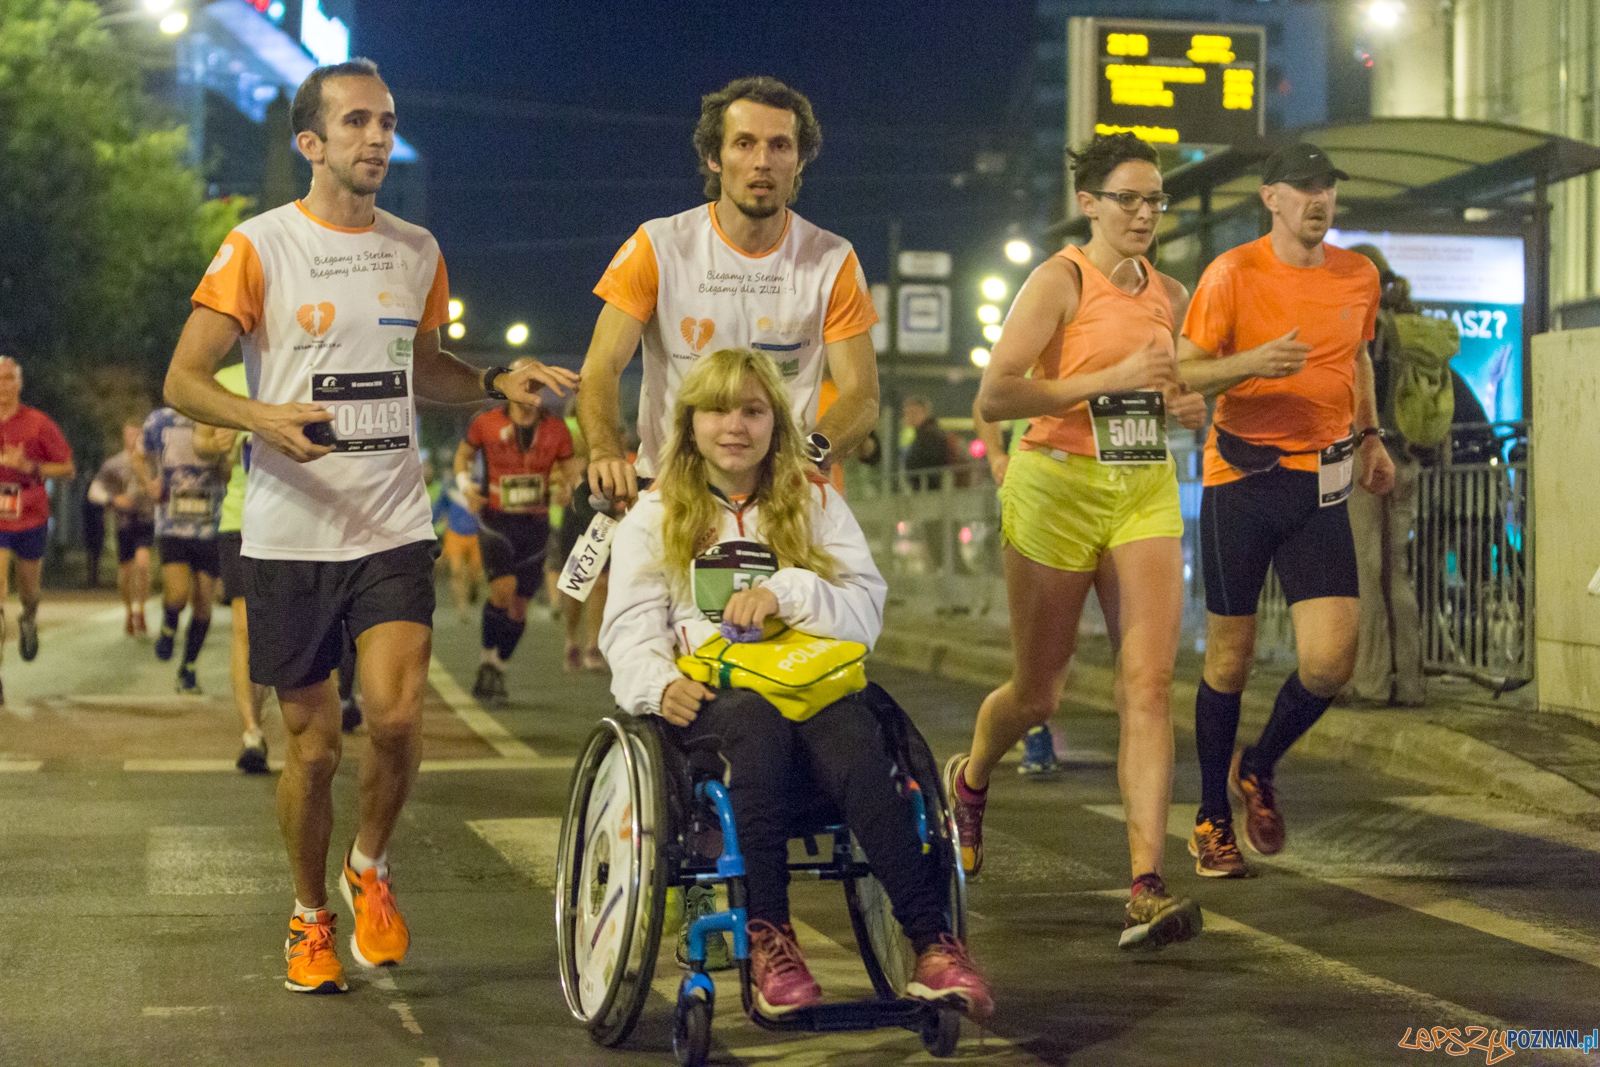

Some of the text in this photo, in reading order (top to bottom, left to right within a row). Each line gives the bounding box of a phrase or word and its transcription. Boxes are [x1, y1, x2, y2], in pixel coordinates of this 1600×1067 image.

[314, 255, 353, 266] Biegamy
[310, 268, 349, 279] Biegamy
[352, 264, 368, 273] dla
[706, 270, 745, 283] Biegamy
[698, 283, 738, 296] Biegamy
[740, 284, 756, 293] dla
[1108, 418, 1158, 447] 5044
[566, 543, 598, 591] W737
